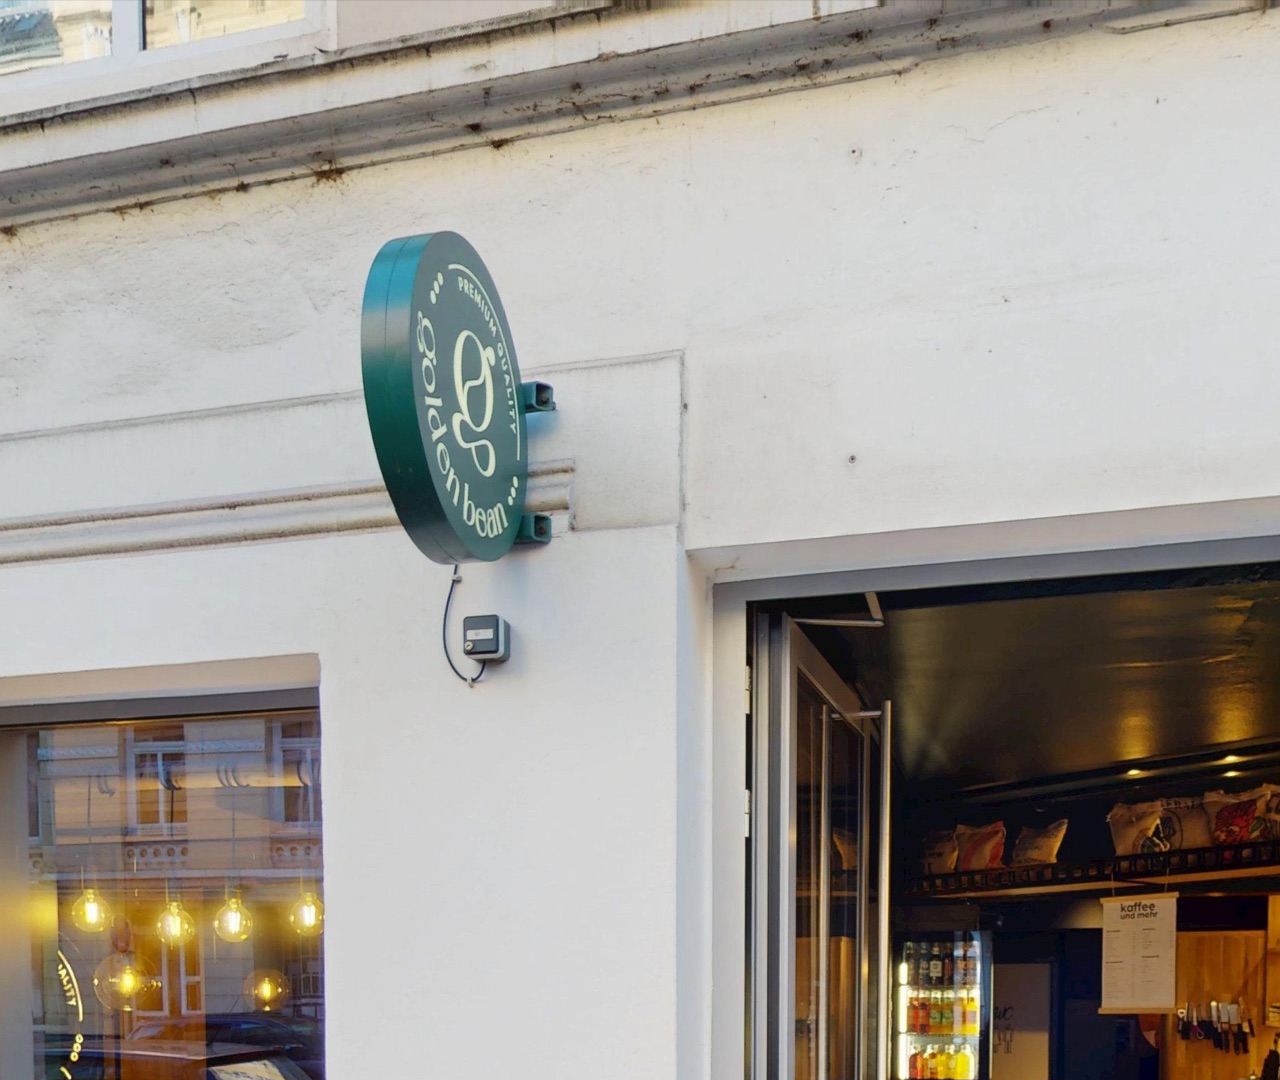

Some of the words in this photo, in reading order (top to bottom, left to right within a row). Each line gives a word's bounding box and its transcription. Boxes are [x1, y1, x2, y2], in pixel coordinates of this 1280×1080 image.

[458, 276, 497, 337] PREMIUM
[497, 342, 517, 435] QUALITY
[416, 310, 460, 507] golden
[463, 482, 509, 539] bean
[1120, 902, 1156, 913] kaffee
[1121, 912, 1135, 920] und
[1137, 911, 1158, 919] mehr
[58, 963, 77, 1006] ALITY
